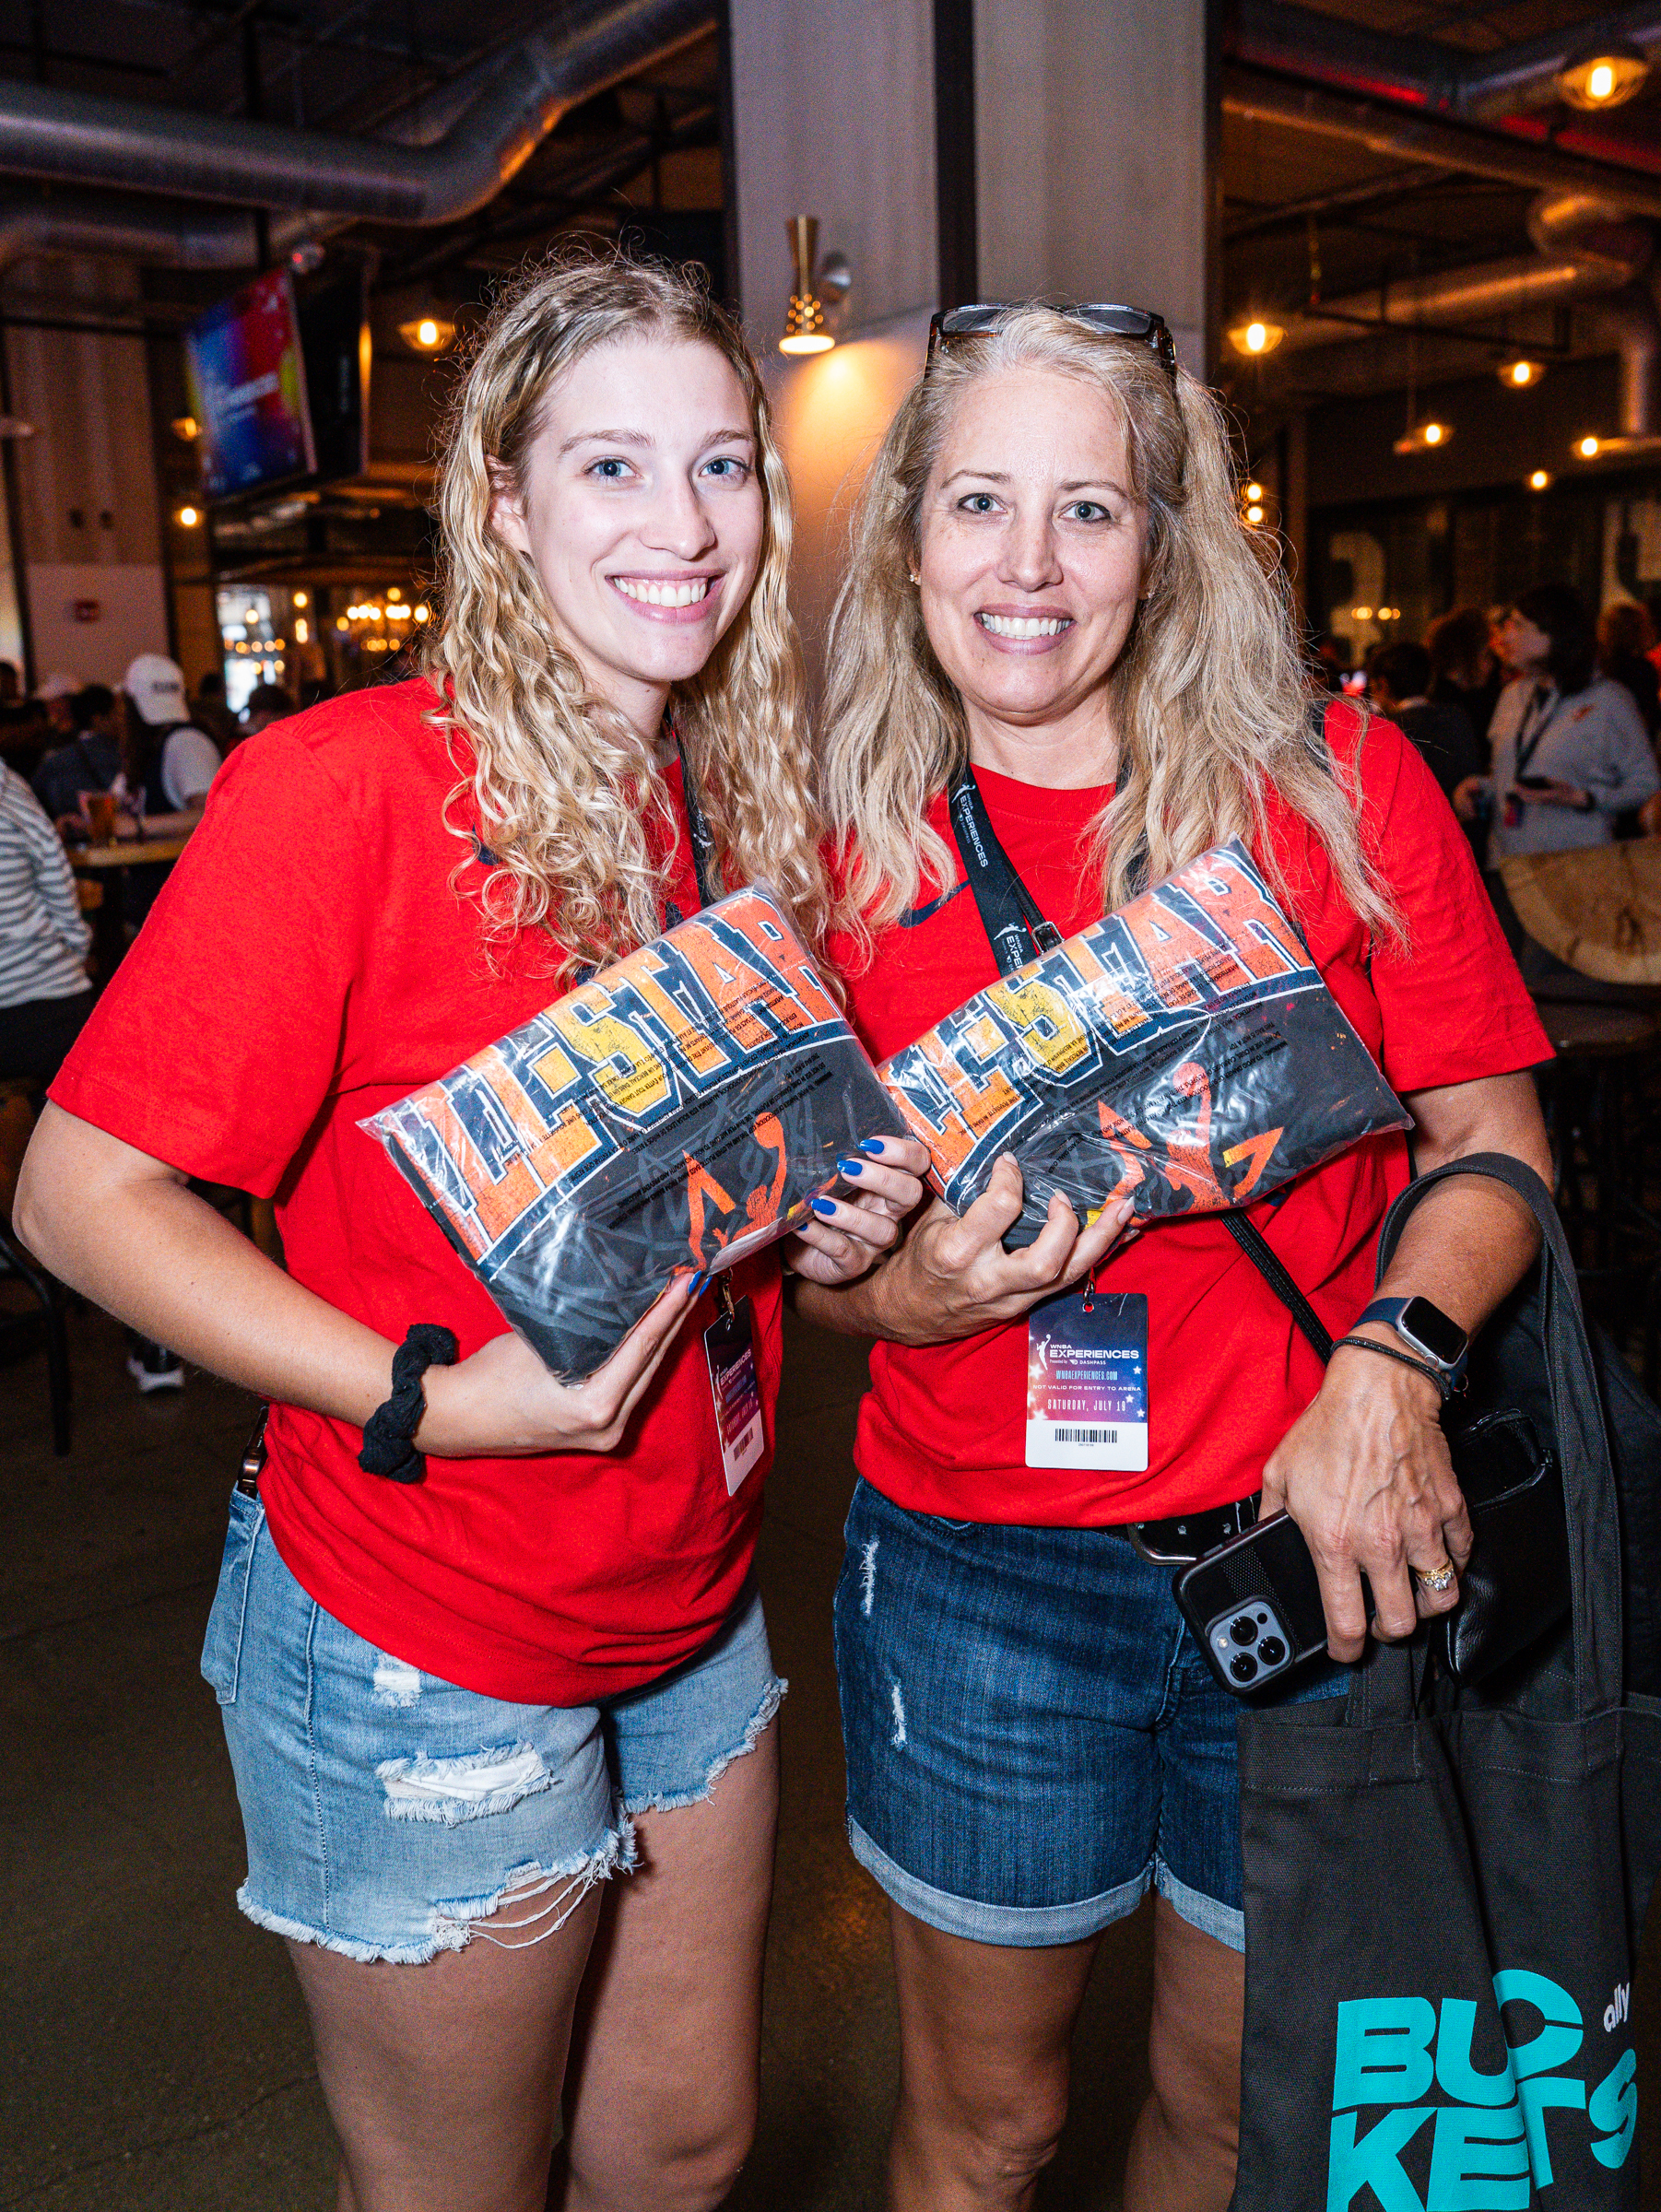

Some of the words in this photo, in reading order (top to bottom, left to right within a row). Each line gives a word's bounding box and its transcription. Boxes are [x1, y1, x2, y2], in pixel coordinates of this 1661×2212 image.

[960, 795, 988, 868] EXPERIENCES
[1015, 934, 1023, 953] WNBA
[1050, 1349, 1139, 1359] EXPERIENCES
[720, 1349, 752, 1386] EXPERIENCES
[1056, 1370, 1118, 1381] WNBAEXPERIENCES.COM
[1047, 1399, 1089, 1412] SATURDAY,
[1094, 1400, 1112, 1411] JULY
[1117, 1400, 1126, 1411] 19
[1603, 1982, 1630, 2033] ally
